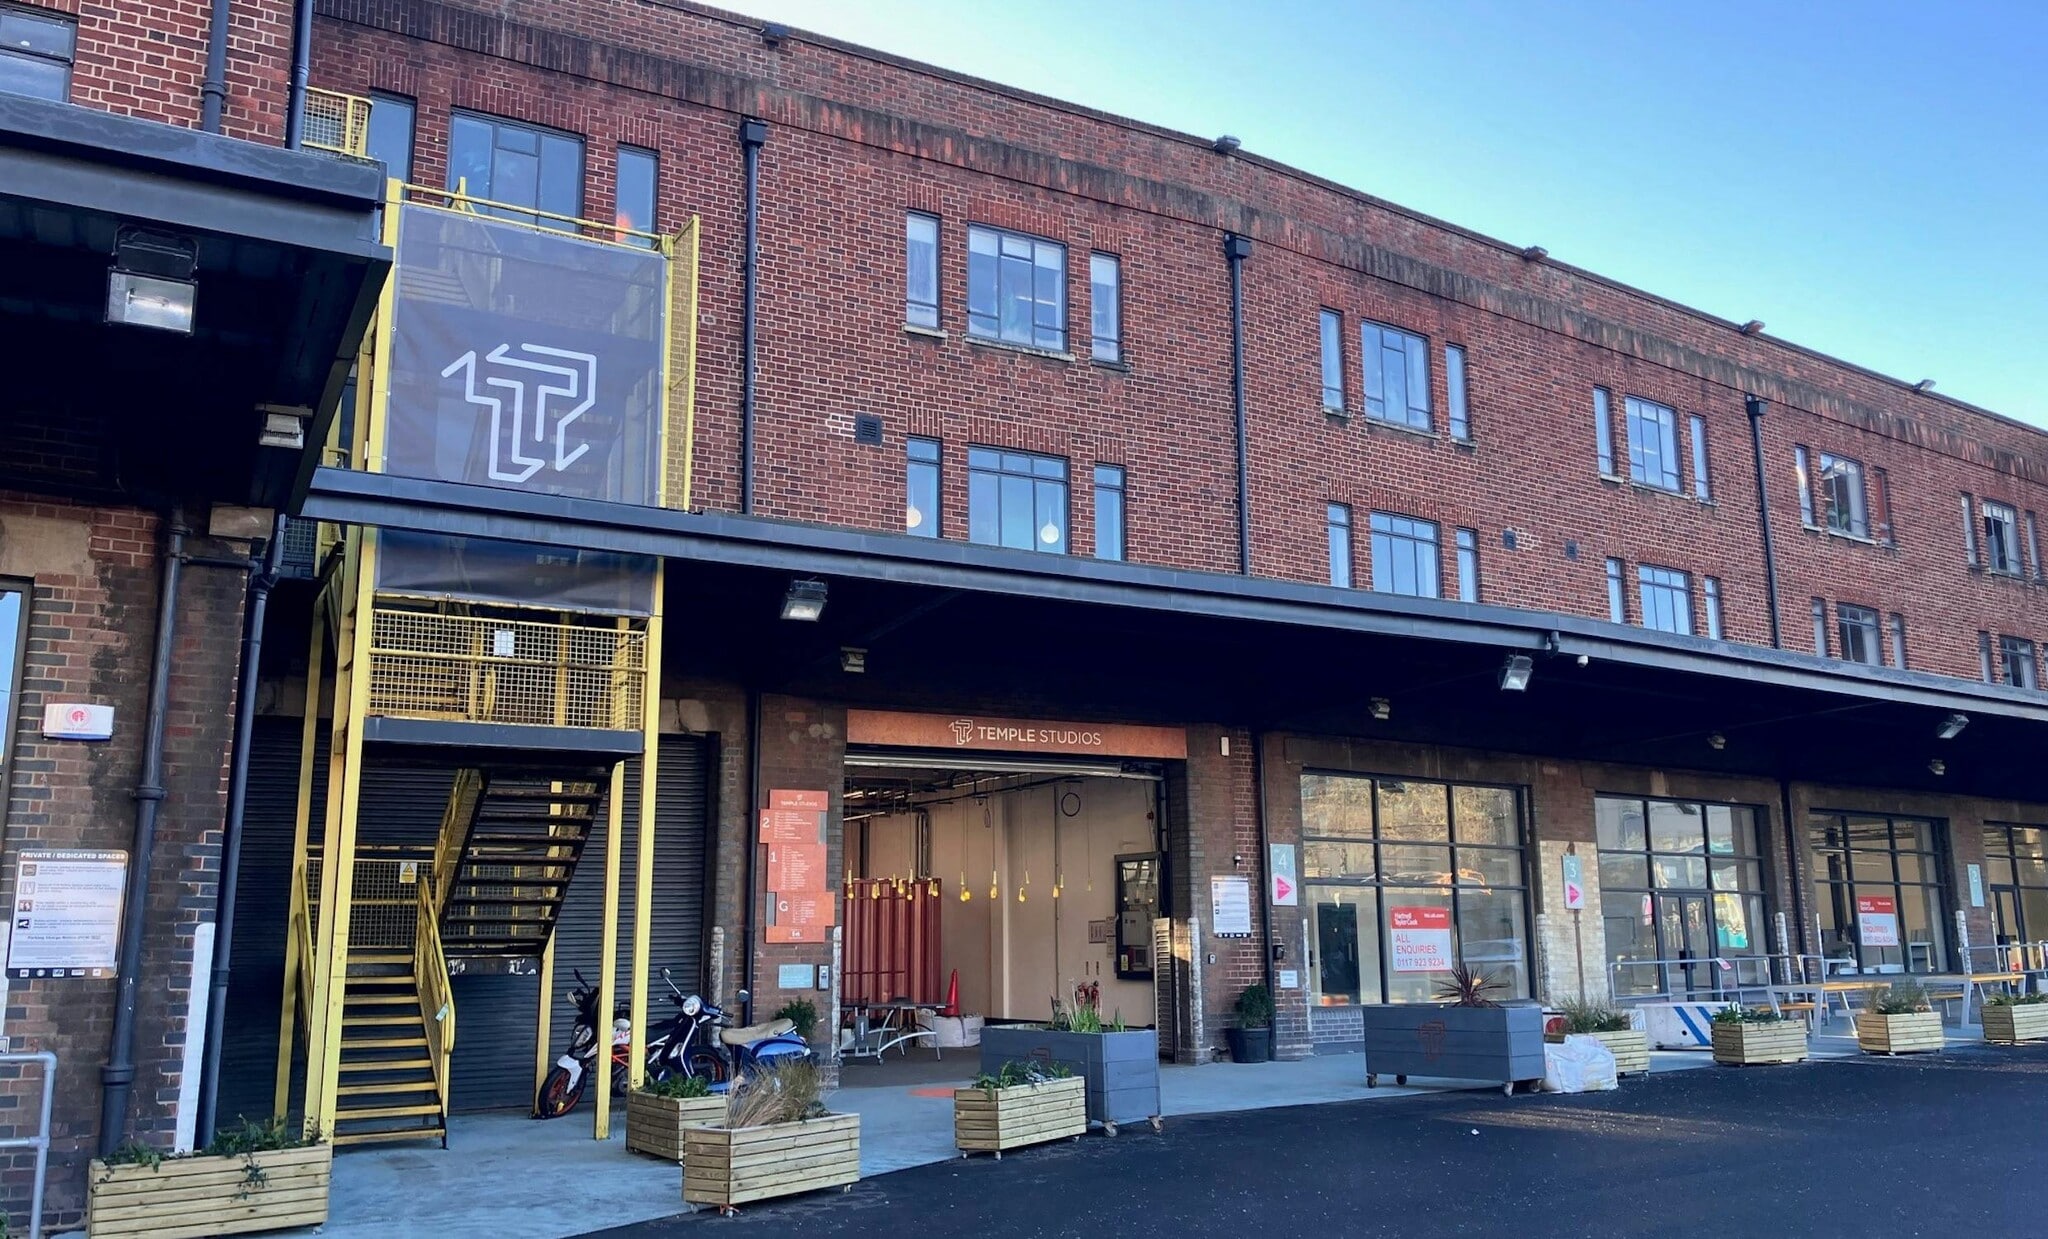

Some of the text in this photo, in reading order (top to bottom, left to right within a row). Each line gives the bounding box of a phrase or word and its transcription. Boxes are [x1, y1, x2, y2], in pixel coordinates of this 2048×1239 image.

[977, 726, 1036, 742] TEMPLE
[1039, 730, 1101, 746] STUDIOS
[762, 817, 770, 828] 2
[770, 851, 777, 863] 1
[1278, 853, 1287, 869] 4
[1569, 863, 1577, 877] 3
[779, 901, 789, 912] G
[1396, 933, 1411, 943] ALL
[1396, 944, 1437, 954] ENQUIRIES
[1397, 957, 1412, 967] 0117
